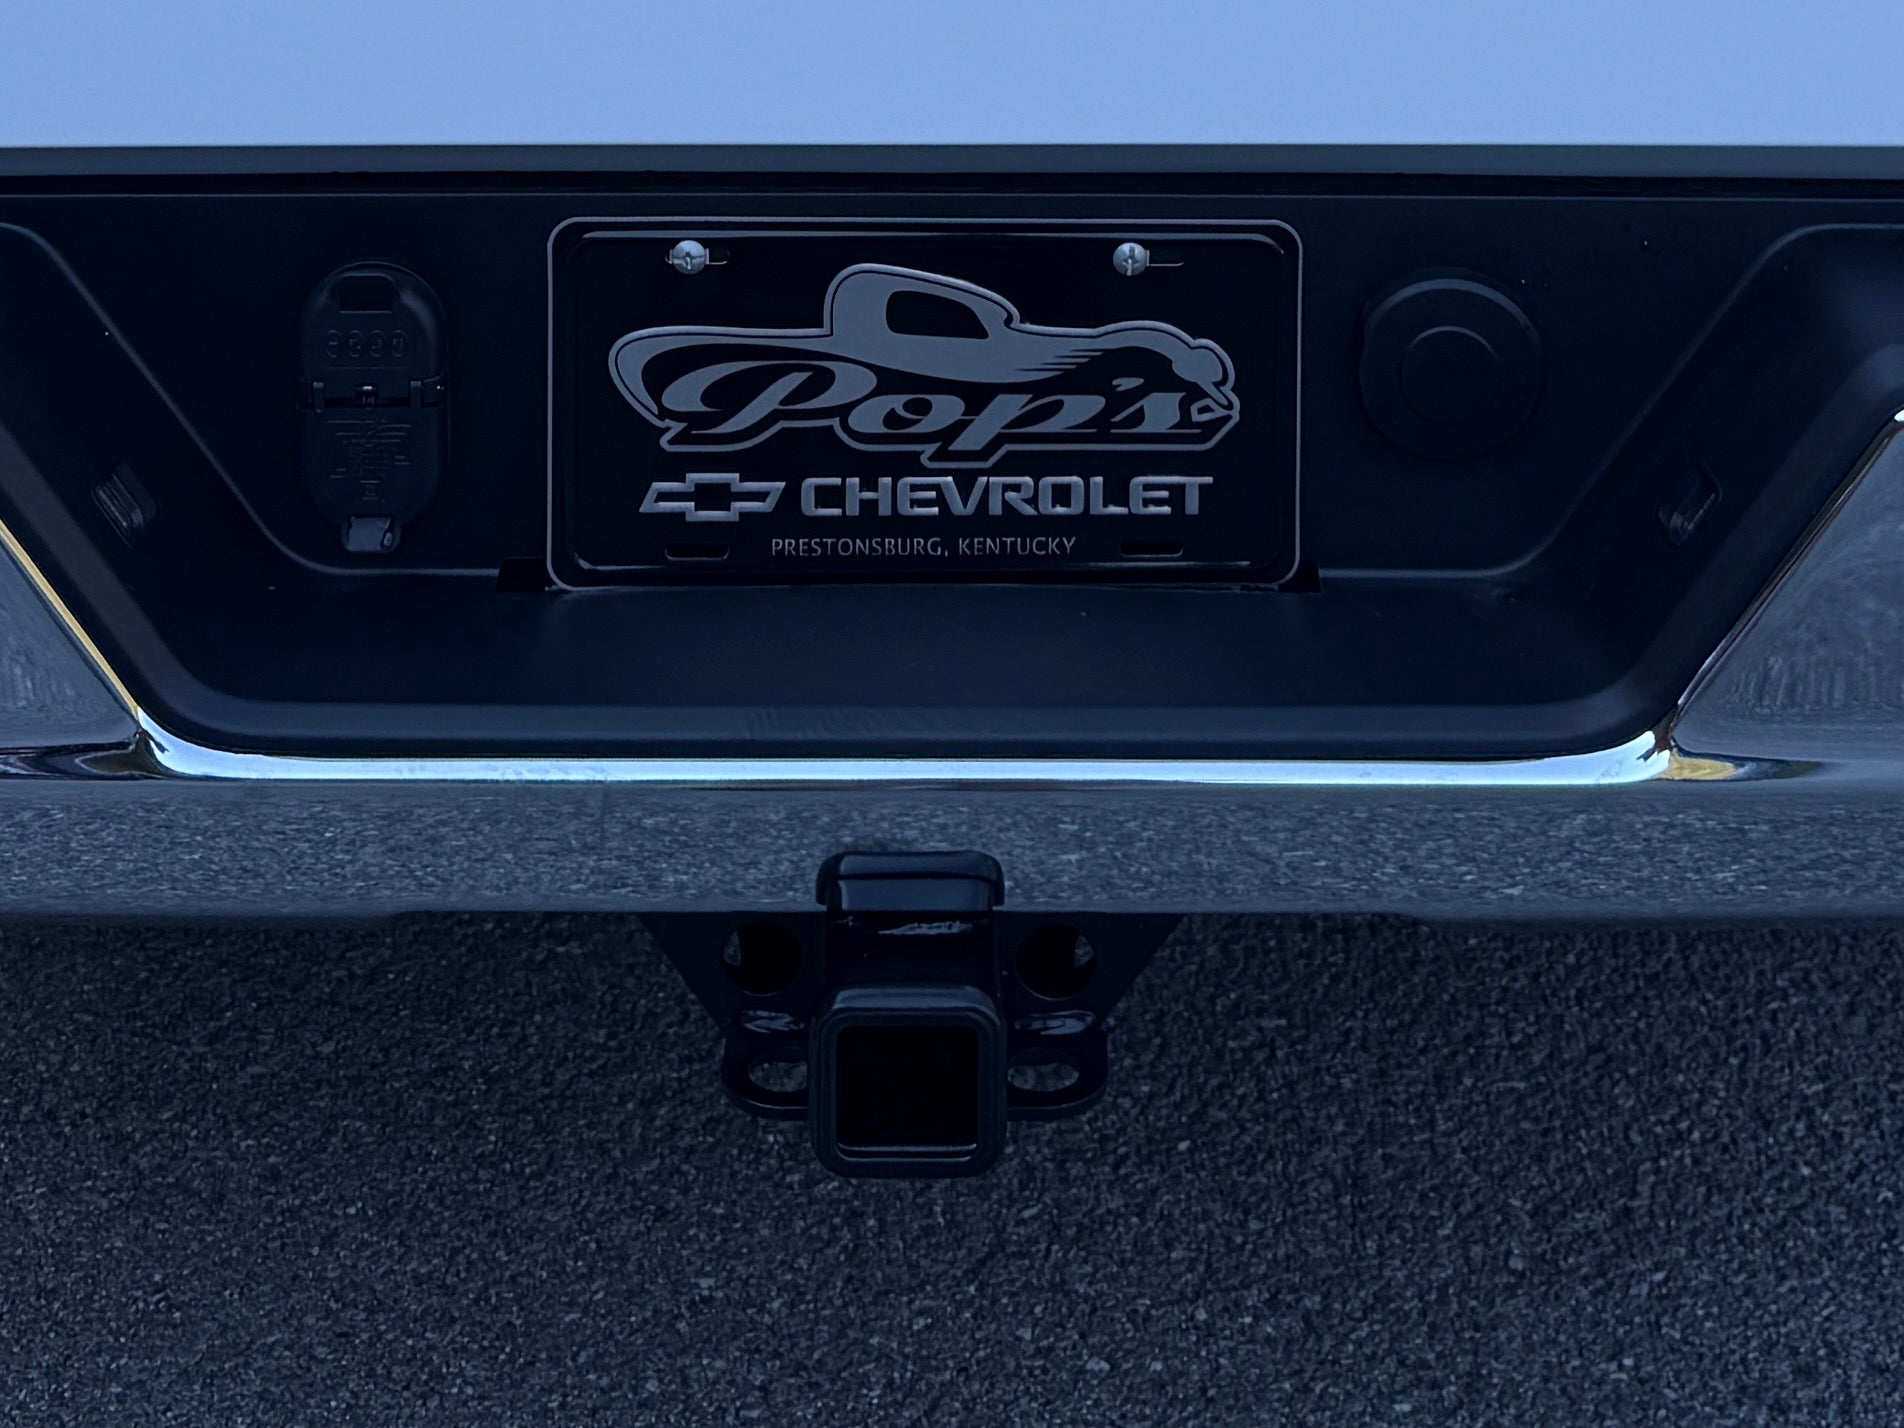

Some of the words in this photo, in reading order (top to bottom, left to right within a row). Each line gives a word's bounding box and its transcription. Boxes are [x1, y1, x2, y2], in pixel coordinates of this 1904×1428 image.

[660, 358, 1203, 451] Pop's
[800, 475, 1215, 519] CHEVROLET
[771, 537, 951, 559] PRESTONSBURG,
[957, 535, 1078, 557] KENTUCKY
